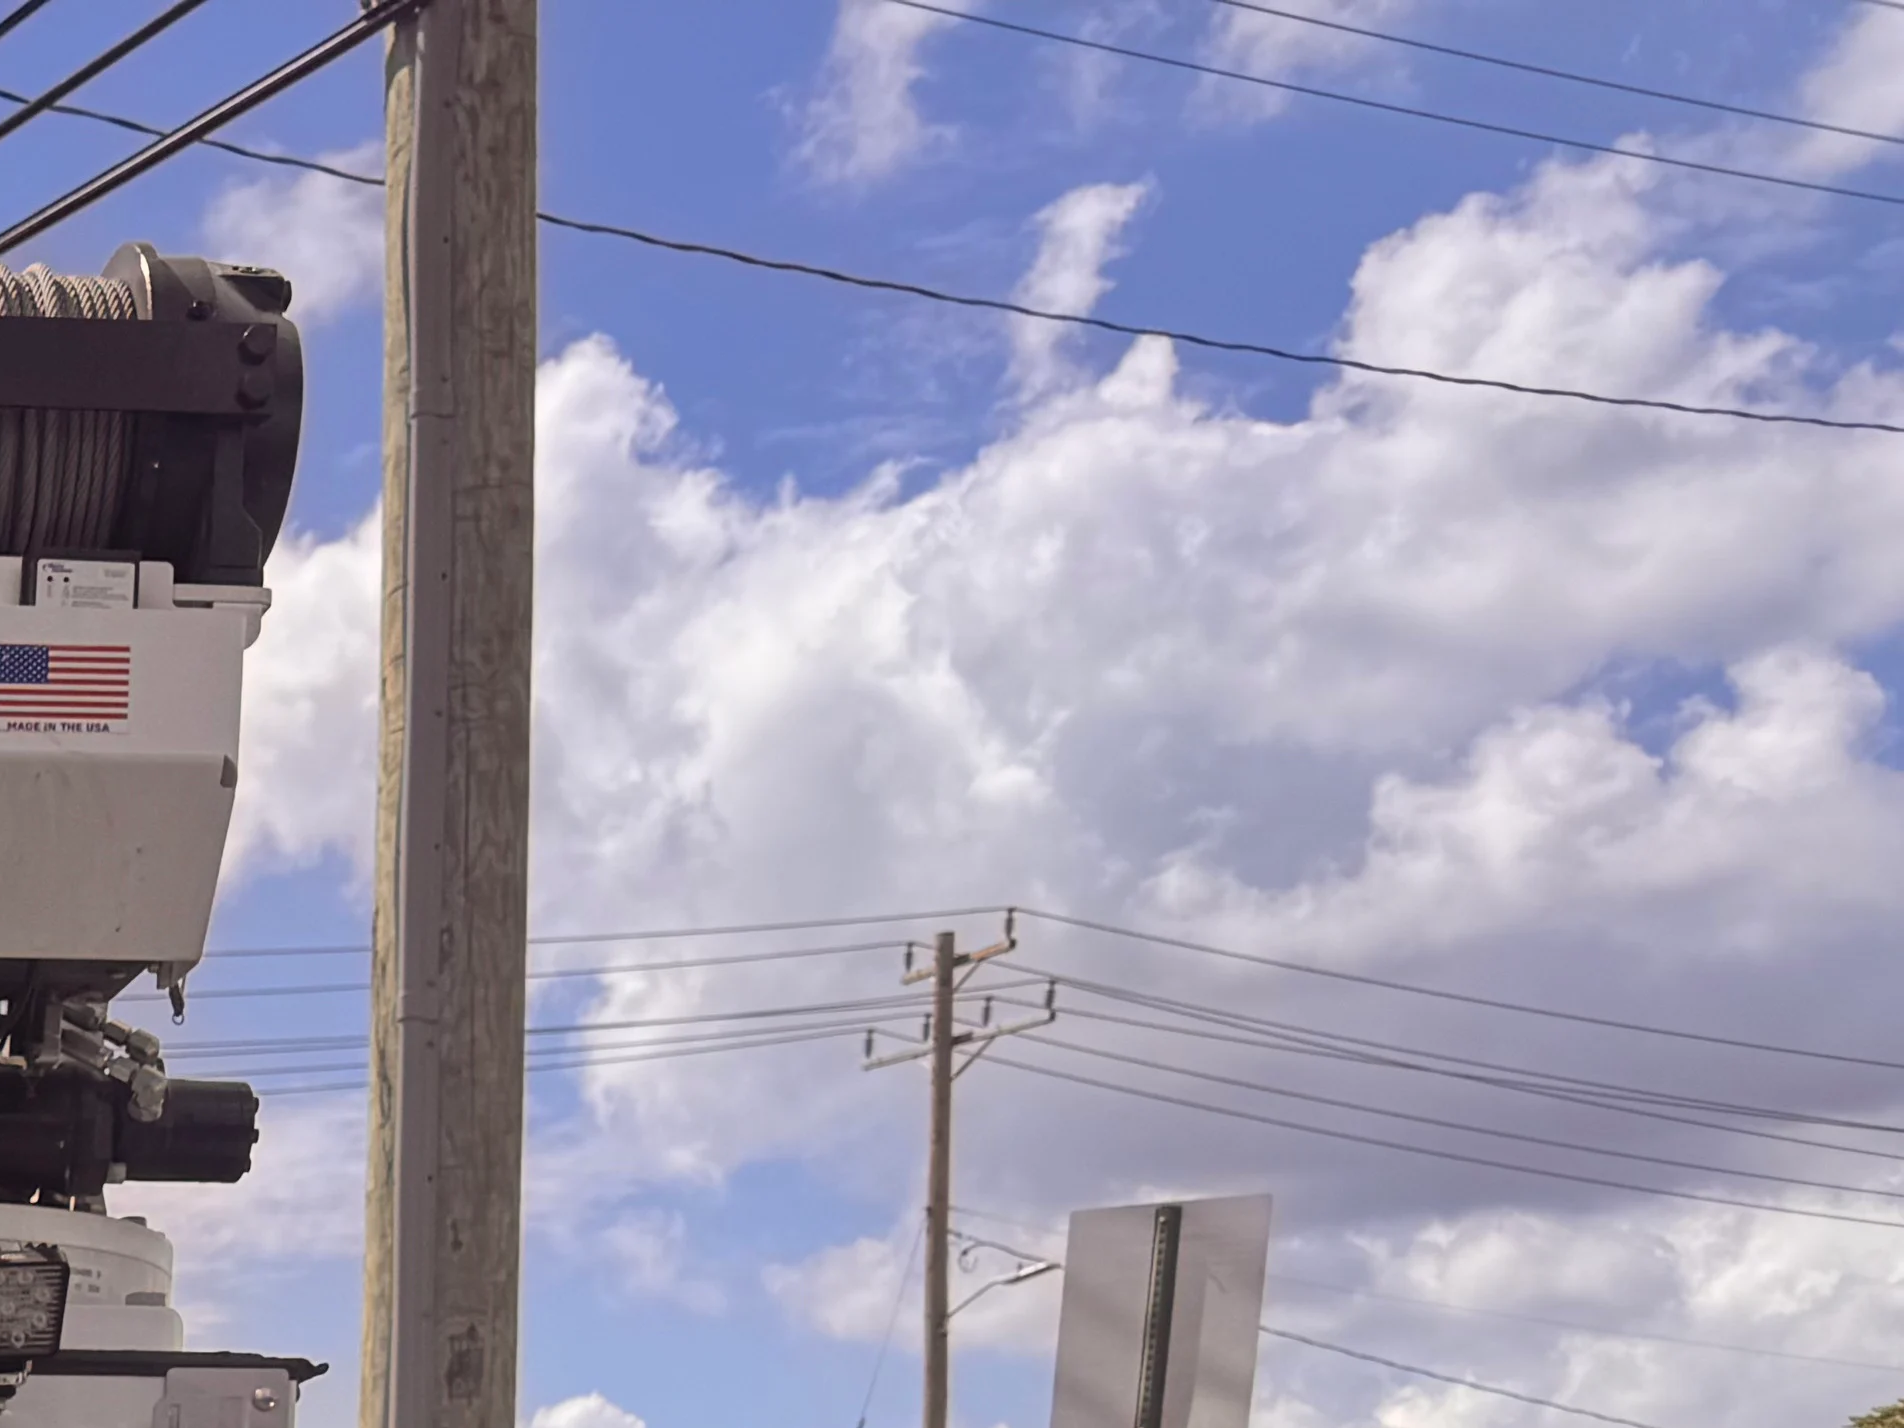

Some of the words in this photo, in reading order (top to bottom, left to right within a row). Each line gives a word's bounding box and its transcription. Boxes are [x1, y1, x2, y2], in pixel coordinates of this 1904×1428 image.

[6, 721, 42, 734] MADE
[43, 722, 56, 732] IN
[60, 722, 83, 733] THE
[86, 722, 110, 733] USA
